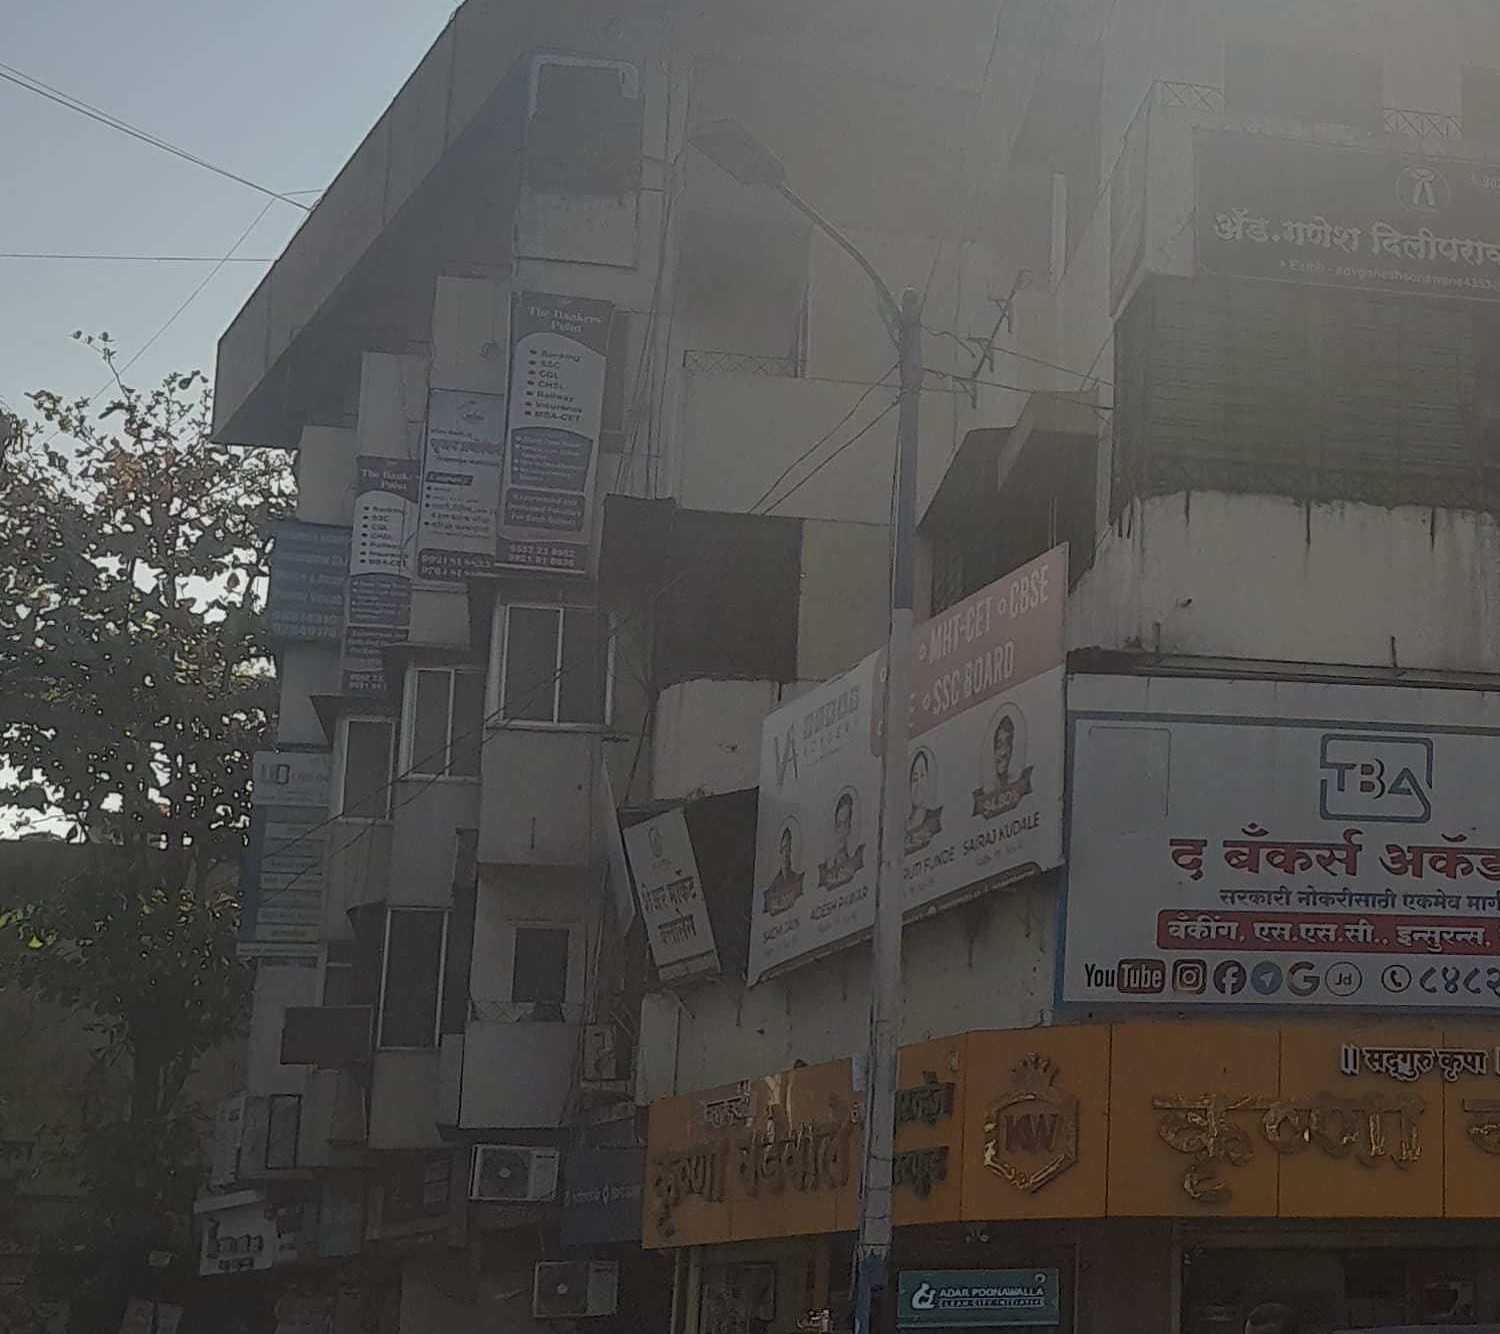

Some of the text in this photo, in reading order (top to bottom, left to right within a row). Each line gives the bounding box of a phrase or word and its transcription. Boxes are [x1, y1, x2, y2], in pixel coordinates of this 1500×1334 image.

[928, 563, 1050, 665] MHT-CET CBSE
[932, 640, 1015, 717] SSC BOARD
[1219, 886, 1291, 907] सरकारी
[1297, 885, 1397, 911] नोकरीसाठी
[1403, 889, 1462, 910] एकमेव
[1084, 961, 1164, 990] YouTube
[1004, 1112, 1060, 1156] KW
[972, 1286, 1044, 1298] POONAWALLA
